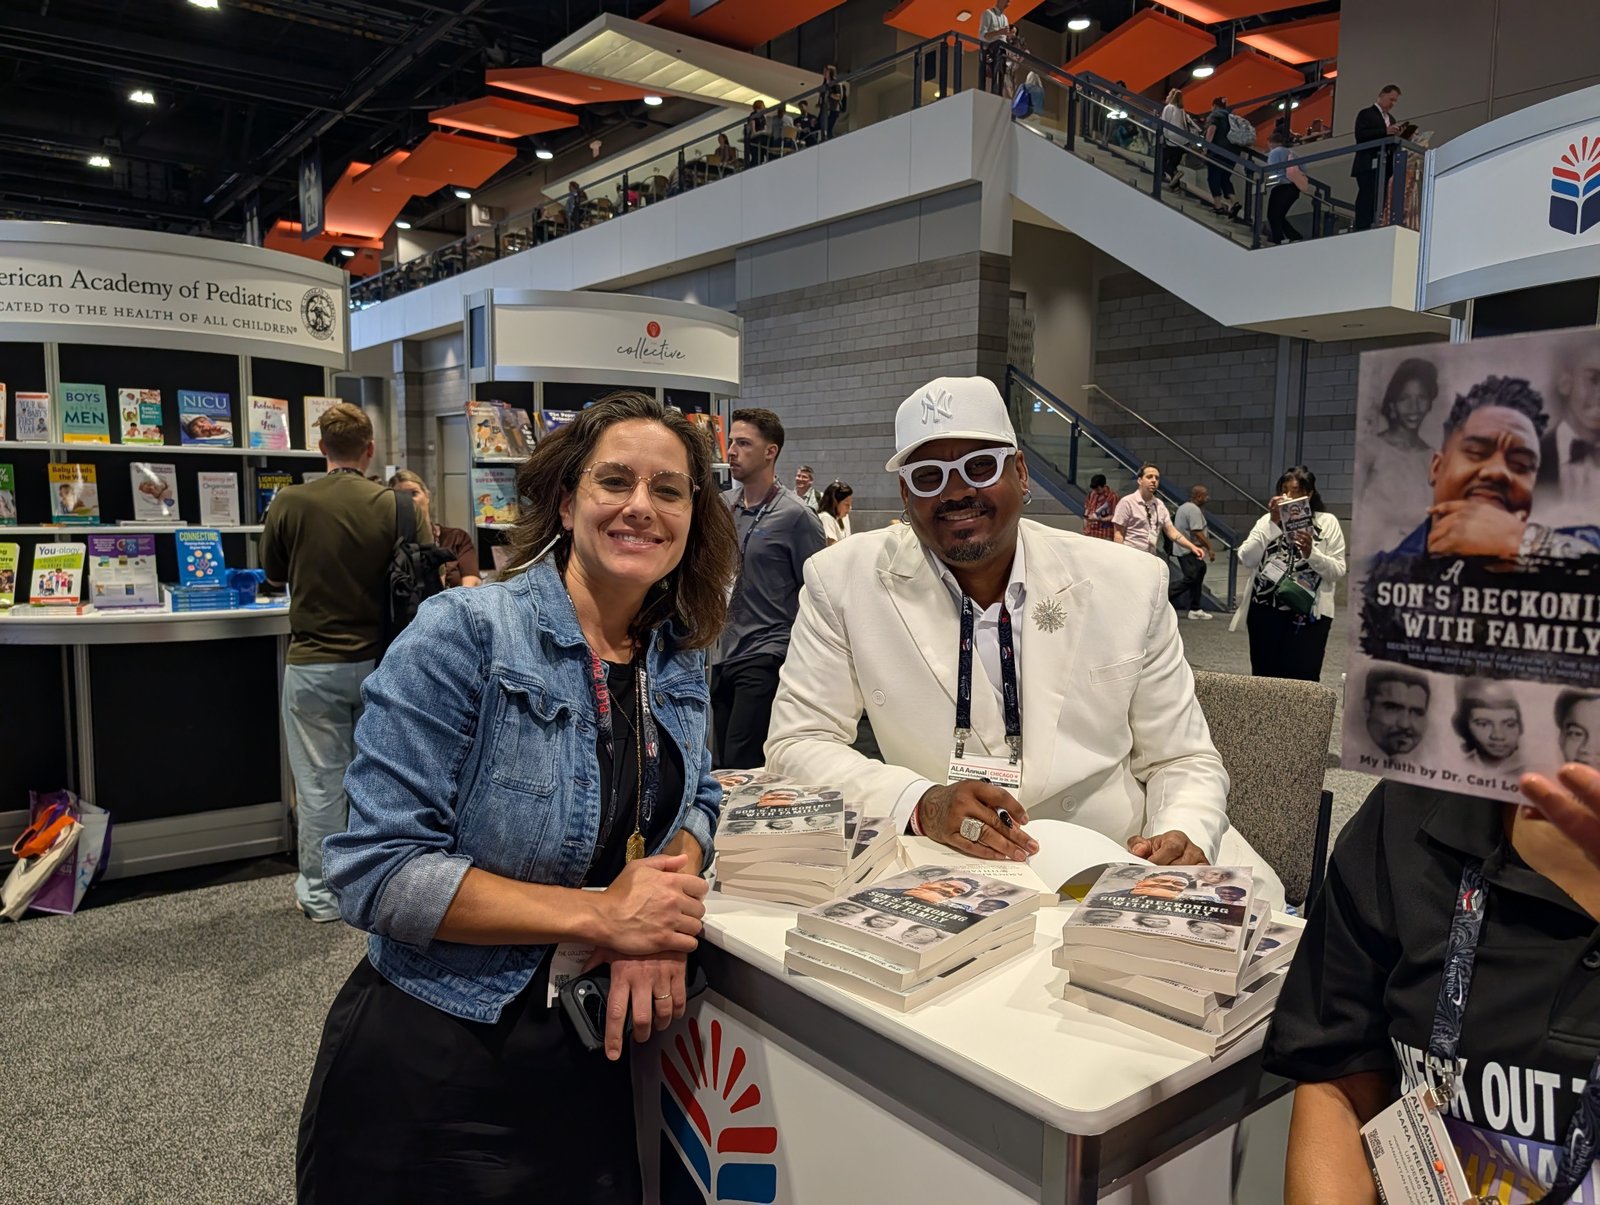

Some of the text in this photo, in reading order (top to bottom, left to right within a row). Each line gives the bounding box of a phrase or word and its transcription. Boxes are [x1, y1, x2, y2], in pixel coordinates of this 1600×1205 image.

[70, 269, 173, 301] Academy
[179, 280, 200, 299] of
[206, 282, 293, 312] Pediatrics
[49, 303, 70, 314] TO
[76, 304, 108, 316] THE
[114, 307, 173, 321] HEALTH
[179, 312, 198, 323] OF
[203, 315, 228, 327] ALL
[616, 337, 686, 360] collective
[66, 392, 101, 403] BOYS
[183, 395, 227, 410] NICU
[64, 410, 105, 425] MEN
[52, 466, 71, 474] Baby
[1440, 559, 1466, 585] A
[1377, 581, 1600, 623] SON'S RECKONI
[1402, 612, 1600, 657] WITH FAMILY
[950, 765, 1014, 779] ALA Annual CHICAGO
[1359, 754, 1379, 768] My
[1383, 758, 1416, 774] truth
[1419, 765, 1437, 780] by
[1441, 769, 1462, 783] Dr.
[1466, 773, 1497, 789] Carl
[769, 803, 831, 813] RECKONING
[779, 807, 821, 816] FAMILY
[867, 890, 969, 922] SON'S RECKONING
[871, 897, 950, 923] WITH FAMILY
[1099, 895, 1229, 915] SON'S RECKONING
[1112, 900, 1214, 917] WITH FAMILY
[1481, 1061, 1561, 1141] OUT
[1411, 1095, 1426, 1123] ALA
[1422, 1125, 1440, 1161] Annua
[1388, 1139, 1406, 1185] MANHATTAN
[1397, 1110, 1434, 1203] SARA FREEMAN
[1410, 1164, 1421, 1190] GEMS
